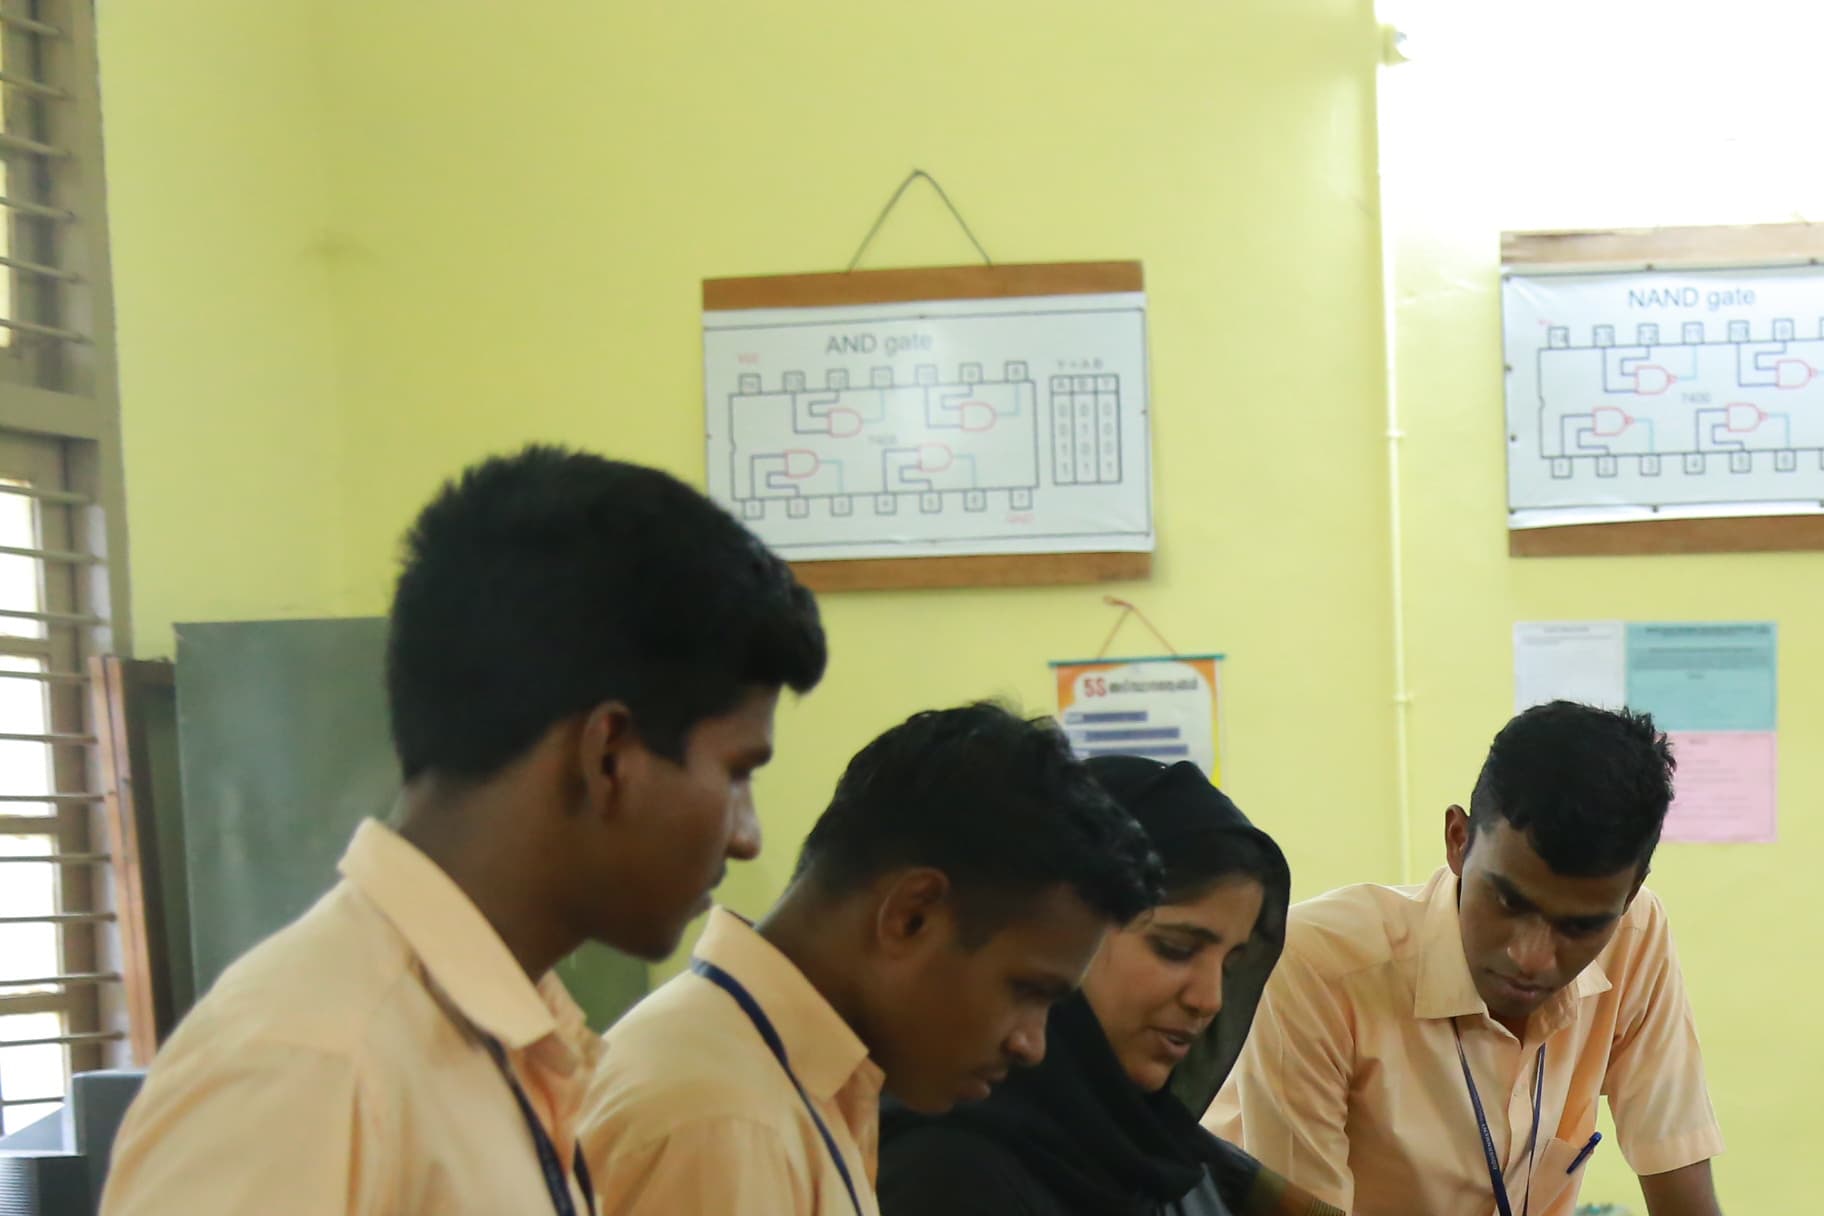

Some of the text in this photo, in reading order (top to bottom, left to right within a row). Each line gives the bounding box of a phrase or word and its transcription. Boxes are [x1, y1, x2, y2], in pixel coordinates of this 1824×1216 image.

[1627, 286, 1756, 312] NAND gate
[825, 332, 933, 358] AND gate
